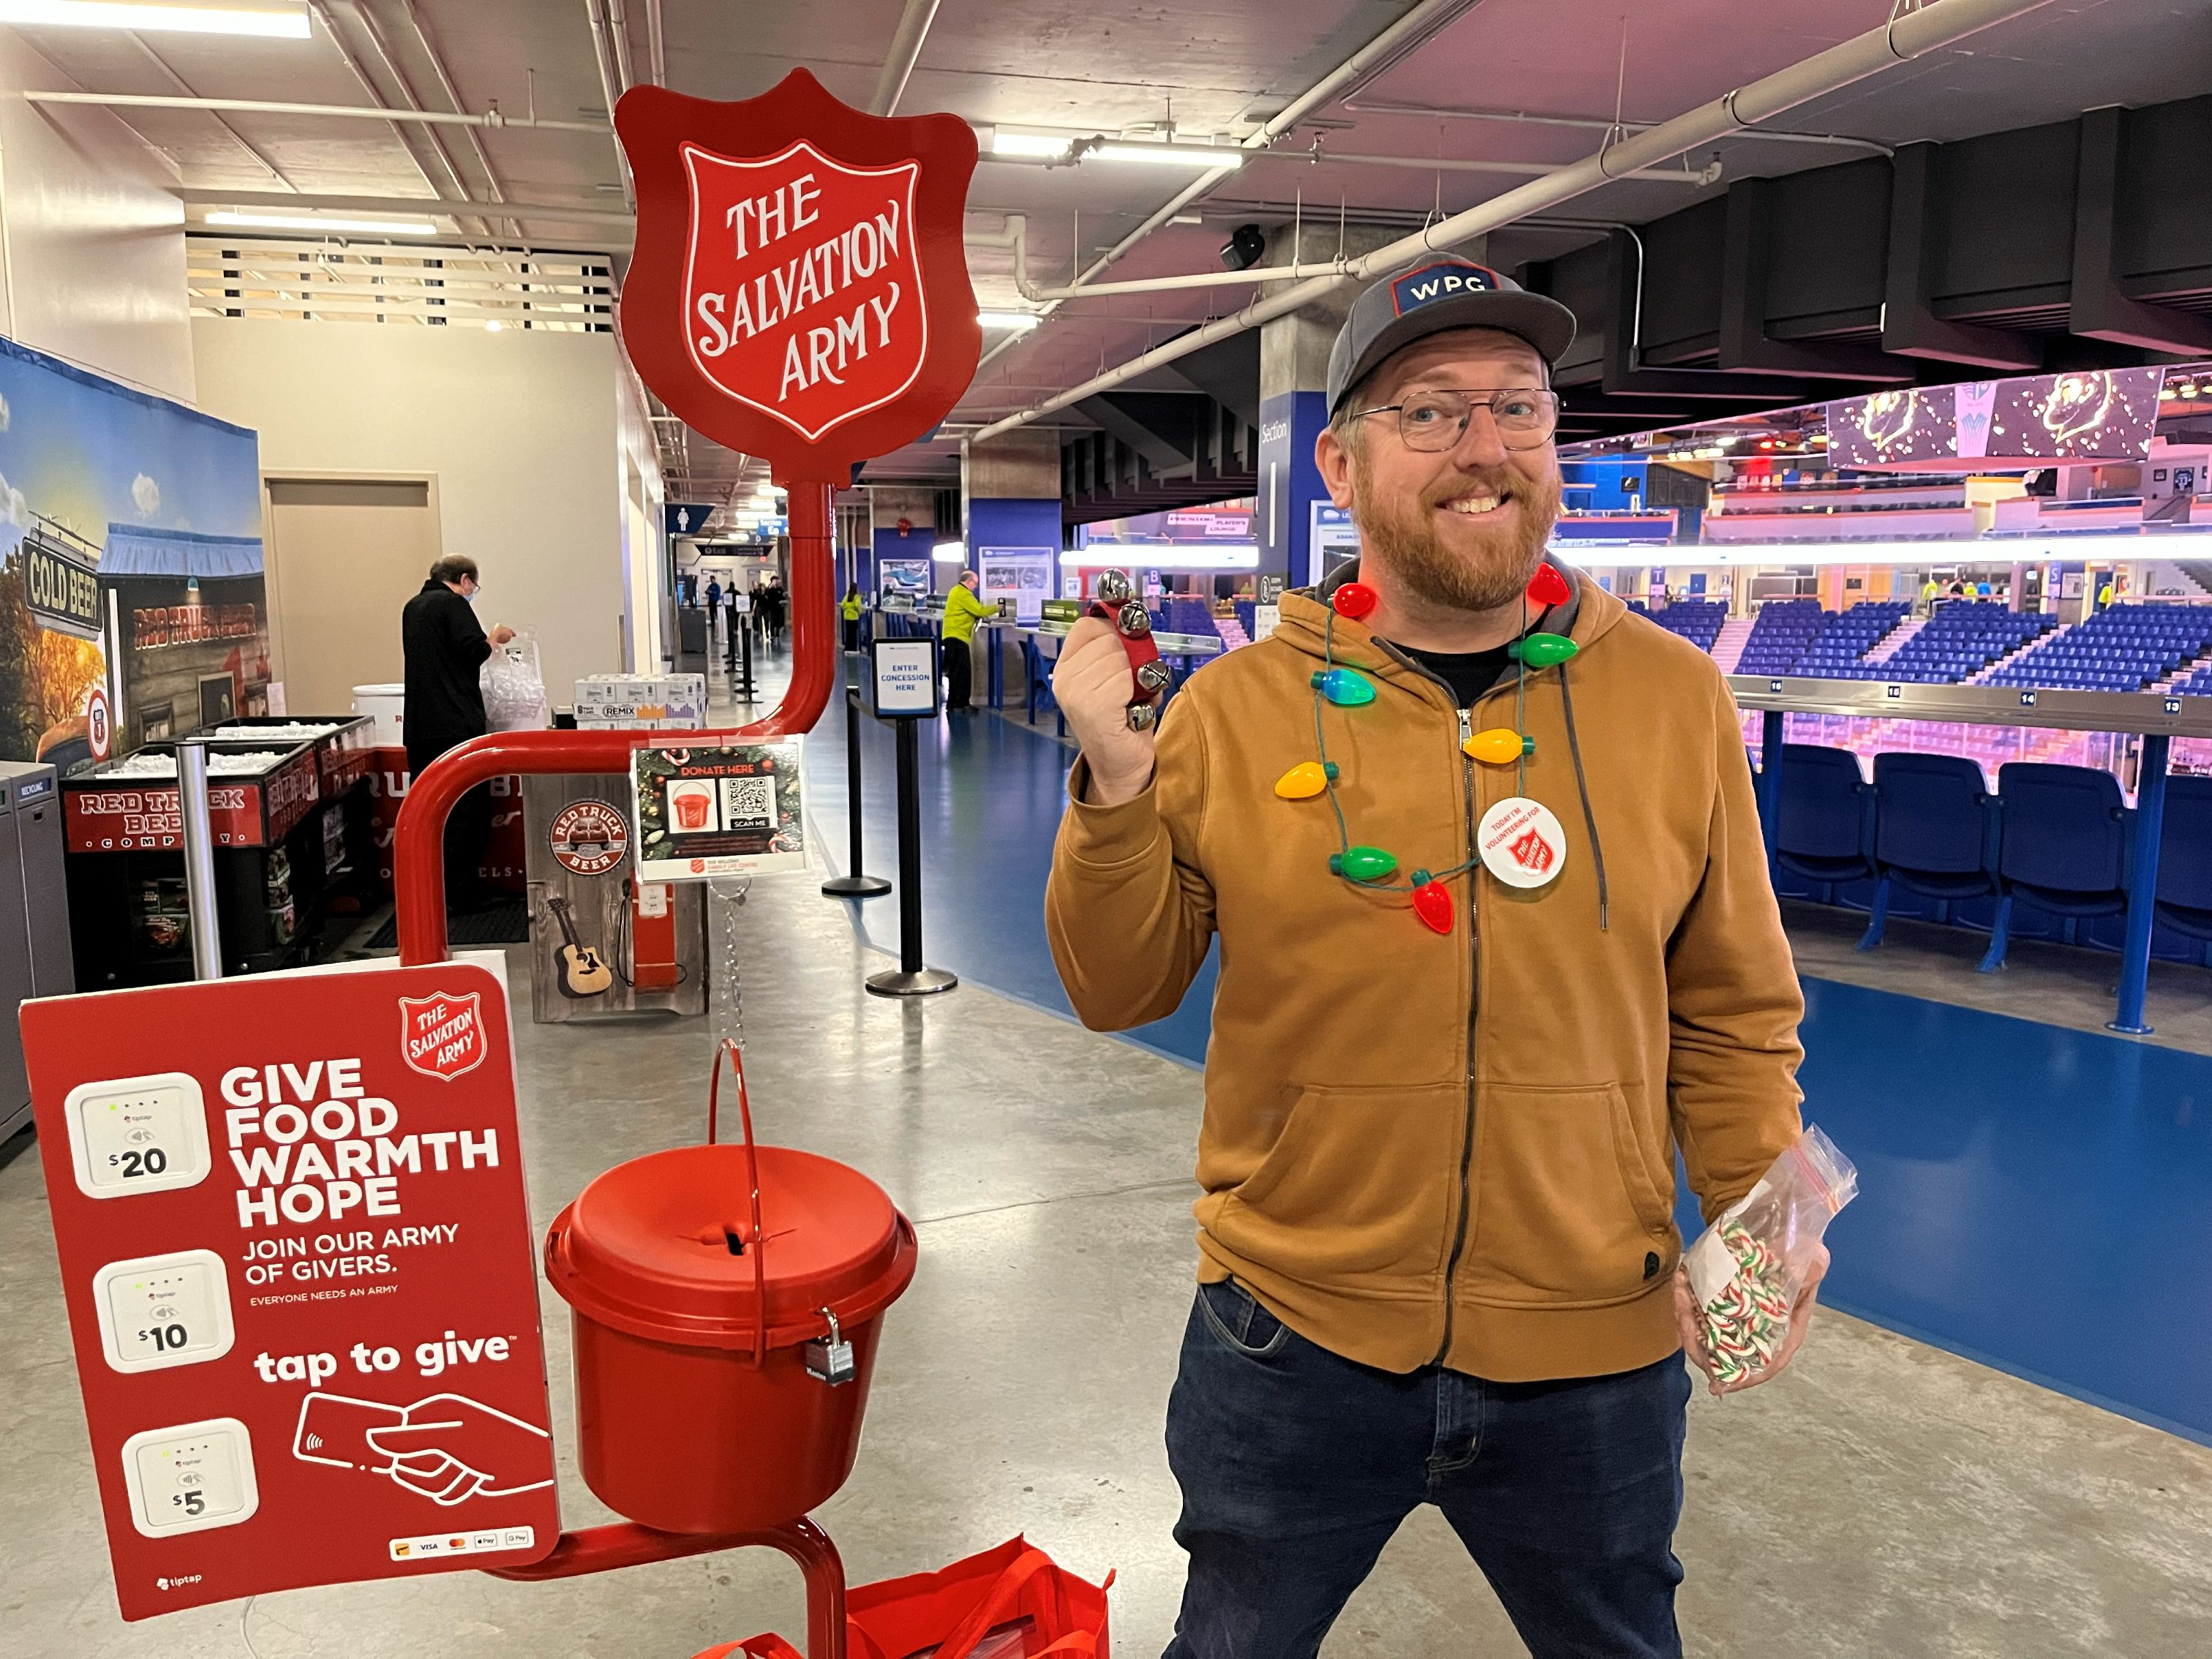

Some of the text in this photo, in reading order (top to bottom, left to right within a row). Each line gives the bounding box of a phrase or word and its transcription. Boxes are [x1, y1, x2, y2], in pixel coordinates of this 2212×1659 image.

[726, 173, 821, 260] THE
[697, 199, 900, 357] SALVATION
[1410, 276, 1485, 301] WPG
[778, 282, 900, 402] ARMY
[1262, 421, 1287, 444] Section
[30, 551, 97, 620] COLD BEER
[1151, 570, 1159, 582] B
[2050, 568, 2058, 582] S
[606, 707, 635, 716] REMIX
[2021, 694, 2035, 703] 14
[2166, 701, 2180, 712] 13
[680, 764, 754, 776] DONATE HERE
[80, 789, 245, 814] RED TRCK
[124, 813, 183, 834] BEE
[556, 806, 622, 837] RED TRUCK
[1485, 806, 1540, 850] VOLUNTEERING FOR
[1491, 807, 1521, 832] TODAY I'M
[101, 833, 231, 849] COMPY
[1517, 839, 1530, 858] THE
[570, 855, 612, 870] BEER
[417, 1004, 447, 1031] THE
[410, 1007, 473, 1058] SALVATION
[436, 1030, 474, 1068] ARMY
[220, 1058, 365, 1107] GIVE
[225, 1097, 399, 1148] FOOD
[109, 1148, 167, 1178] $20
[228, 1128, 500, 1187] WARMTH
[236, 1176, 402, 1228] HOPE
[242, 1223, 459, 1260] JOIN OUR ARMY
[245, 1254, 397, 1284] OF GIVERS.
[250, 1285, 398, 1306] EVERYONE NEEDS AN ARMY
[138, 1324, 187, 1352] $10
[254, 1352, 337, 1388] tap
[350, 1342, 401, 1373] to
[173, 1490, 206, 1516] $5
[420, 1543, 438, 1551] VISA
[170, 1574, 202, 1587] tiptap
